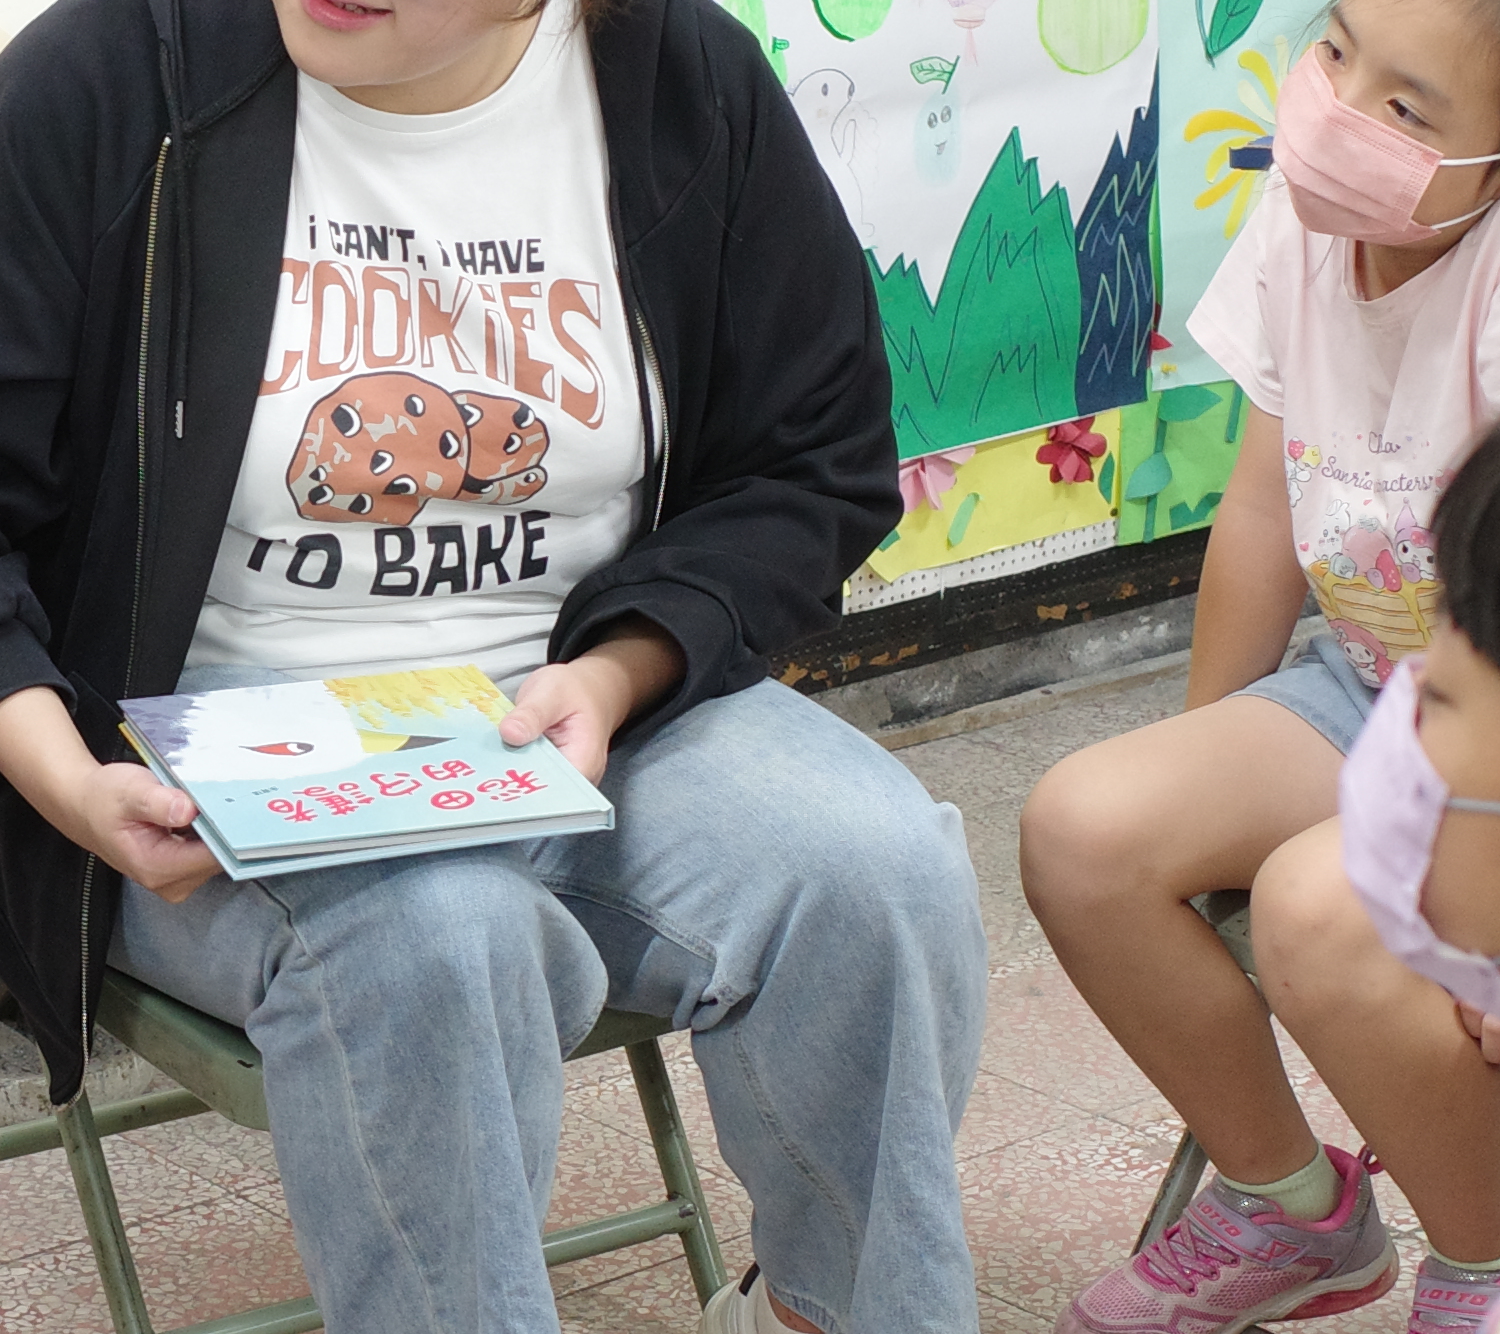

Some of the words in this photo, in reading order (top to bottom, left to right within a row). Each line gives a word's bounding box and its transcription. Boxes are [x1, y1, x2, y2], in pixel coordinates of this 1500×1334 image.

[458, 237, 546, 275] HAVE
[246, 533, 343, 590] TO
[369, 510, 552, 598] BAKE
[1195, 1200, 1243, 1238] LOTTO
[1418, 1286, 1490, 1306] LOTTO
